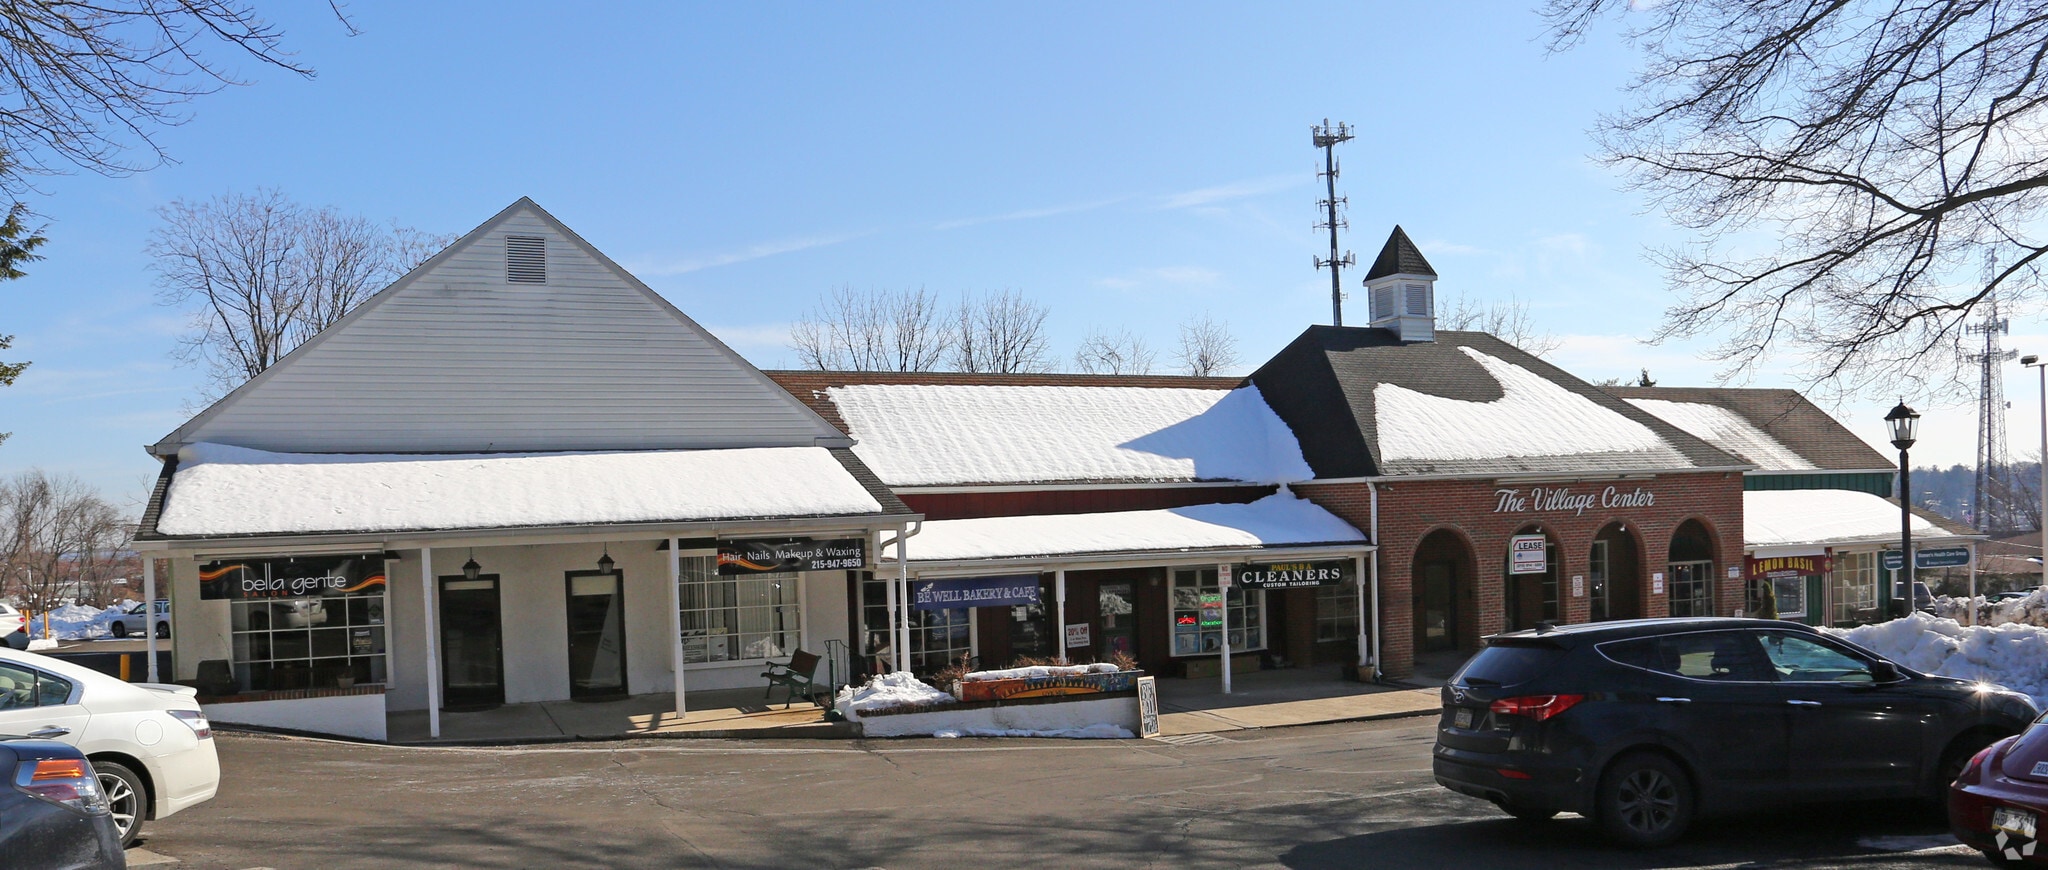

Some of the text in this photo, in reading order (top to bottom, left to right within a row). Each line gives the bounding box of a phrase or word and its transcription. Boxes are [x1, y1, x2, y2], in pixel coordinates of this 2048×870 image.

[1494, 485, 1654, 516] The Village Center
[1518, 541, 1542, 550] LEASE
[722, 547, 861, 562] Hair Nails Makeup & Waxing
[811, 558, 862, 569] 215-947-9650
[1752, 558, 1784, 576] LEMON
[1787, 557, 1815, 572] BASIL
[241, 562, 346, 595] bella gente
[1241, 568, 1341, 583] CLEANERS
[243, 589, 288, 598] SALON
[917, 585, 1036, 603] BE WELL BAKERY & CAFE
